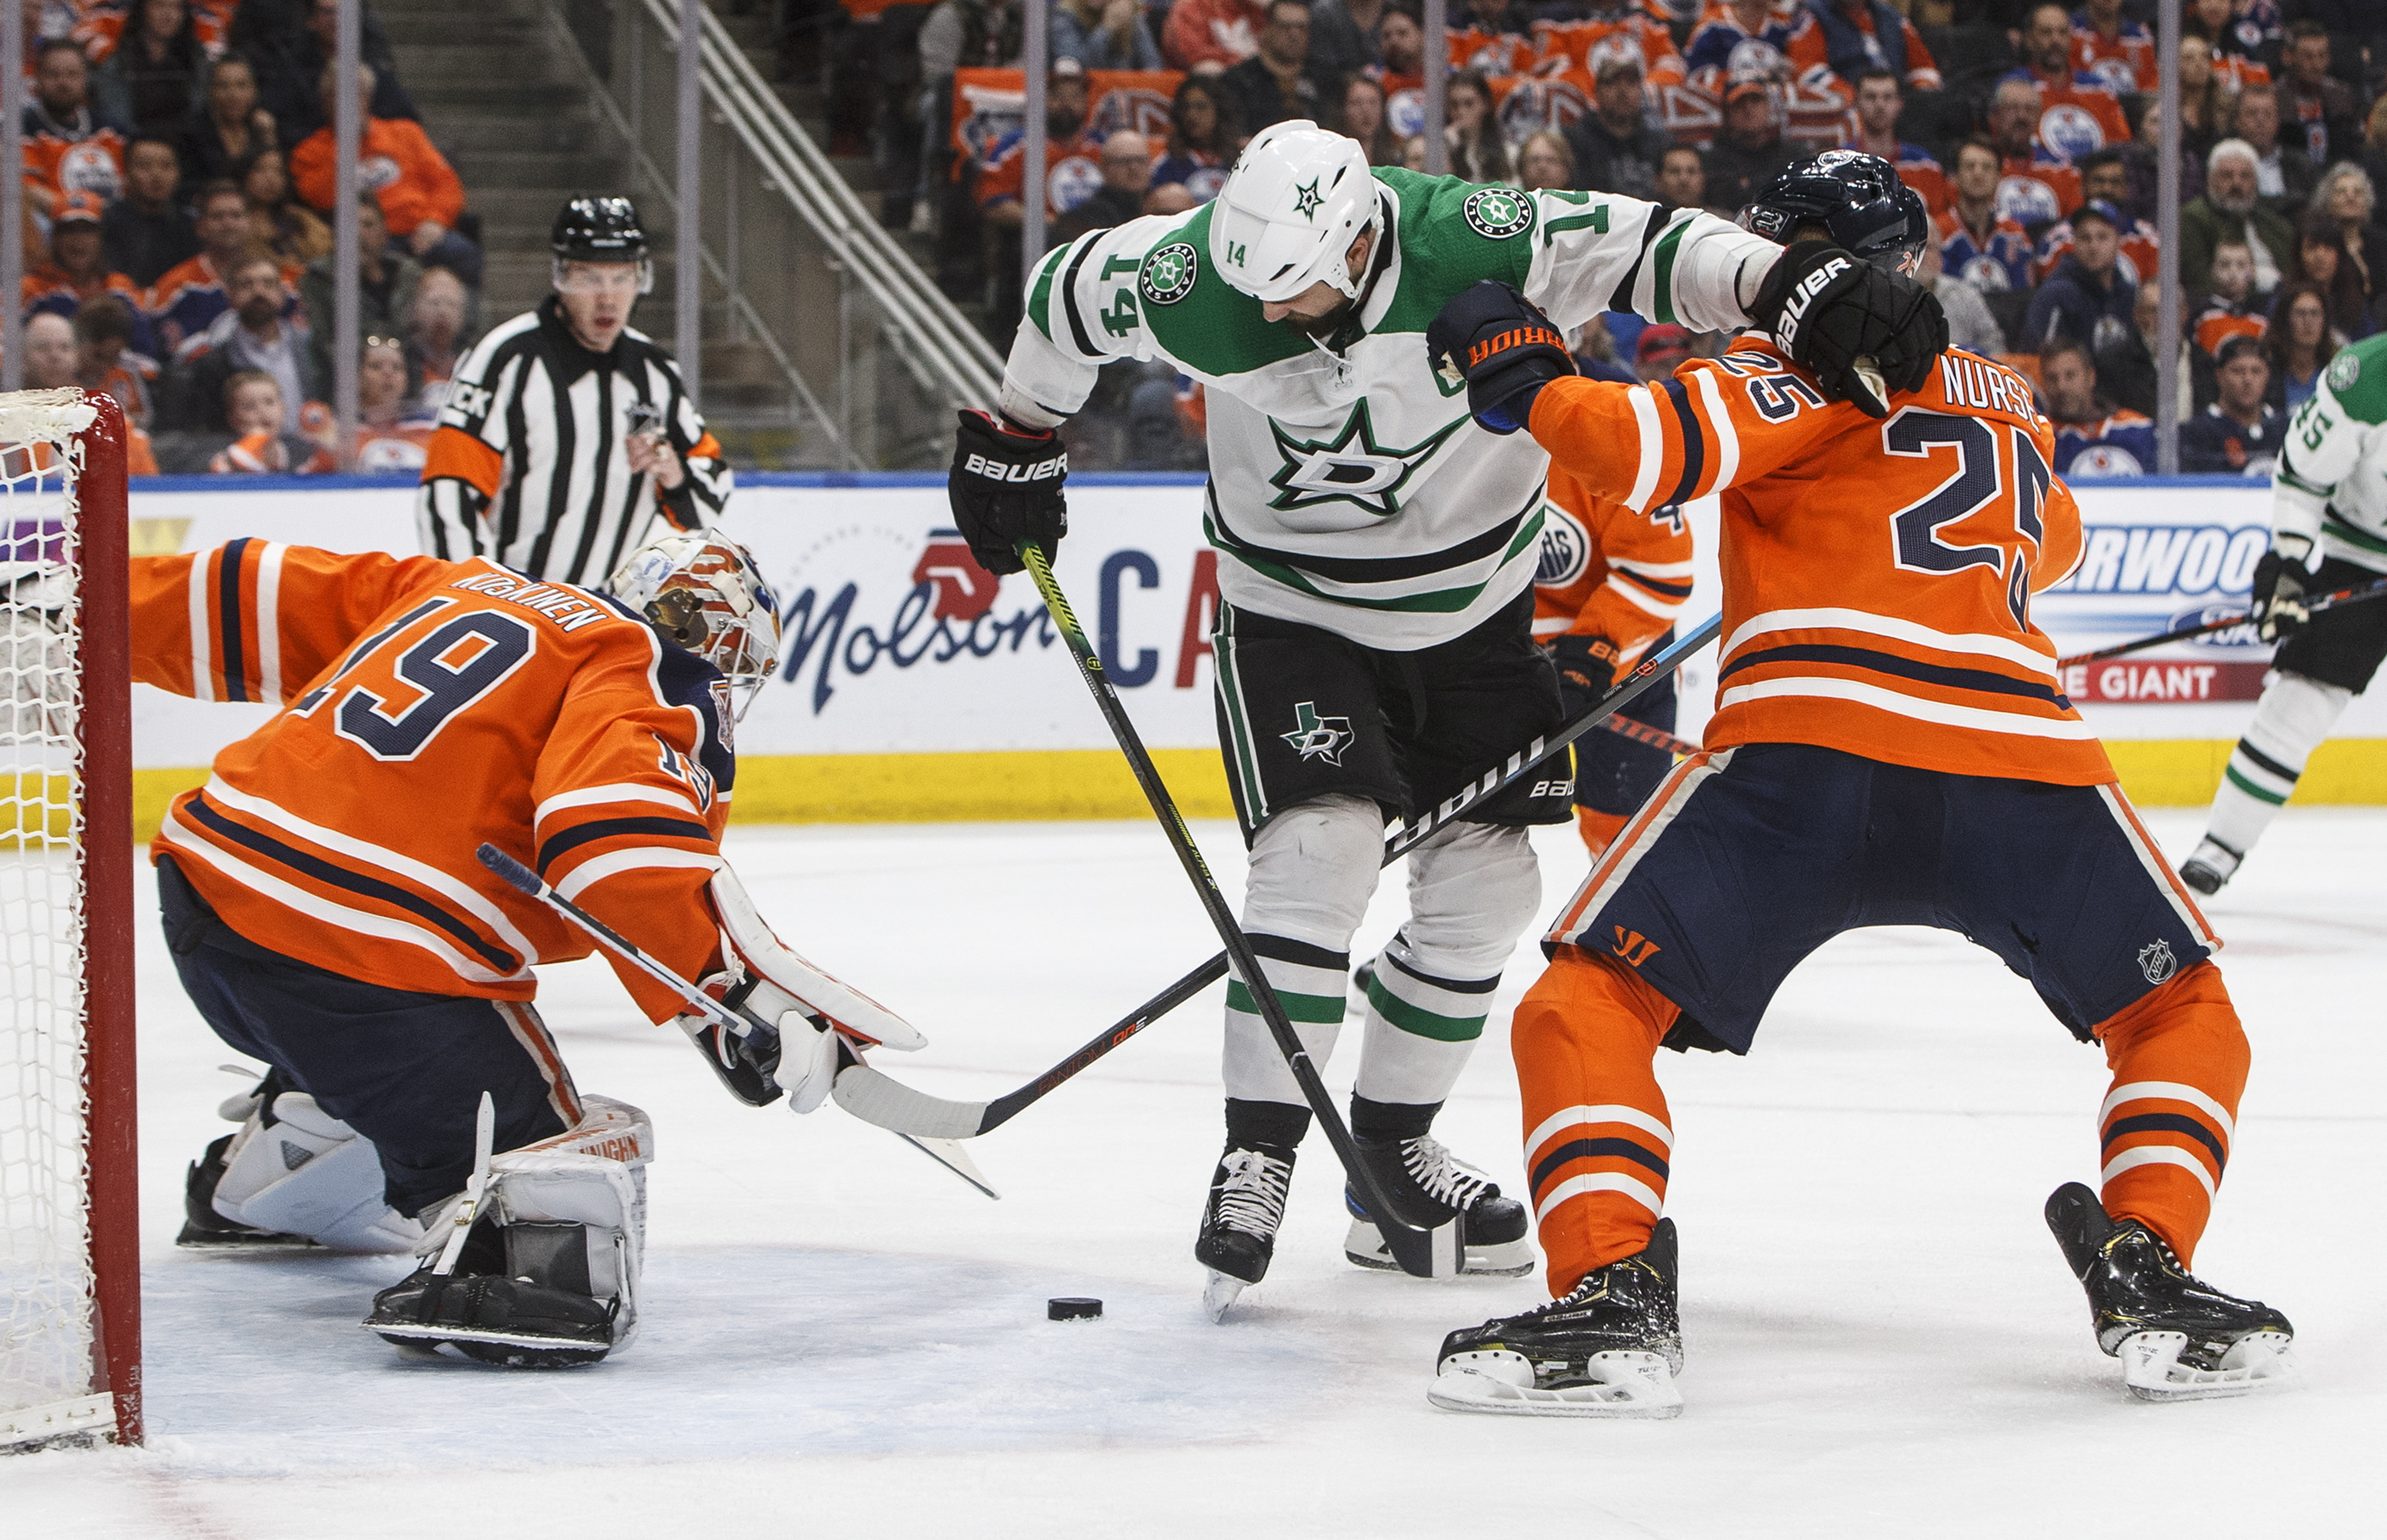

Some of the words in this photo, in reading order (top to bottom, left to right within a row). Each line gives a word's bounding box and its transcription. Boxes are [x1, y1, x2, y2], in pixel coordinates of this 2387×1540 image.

[1226, 240, 1246, 268] 14
[1100, 254, 1142, 339] 14
[1776, 257, 1852, 360] BAUER
[1722, 350, 1828, 425] 25
[1941, 354, 2040, 434] NURSE
[964, 452, 1068, 483] BAUER
[1881, 405, 2052, 633] 25
[450, 572, 609, 632] KOSKINEN
[1027, 543, 1084, 635] WARRIOR
[287, 595, 537, 763] 19
[774, 581, 1056, 715] Molson
[2098, 665, 2217, 699] GIANT
[653, 731, 713, 817] 19
[2151, 951, 2166, 978] NHL
[1036, 1040, 1107, 1097] FANTOM
